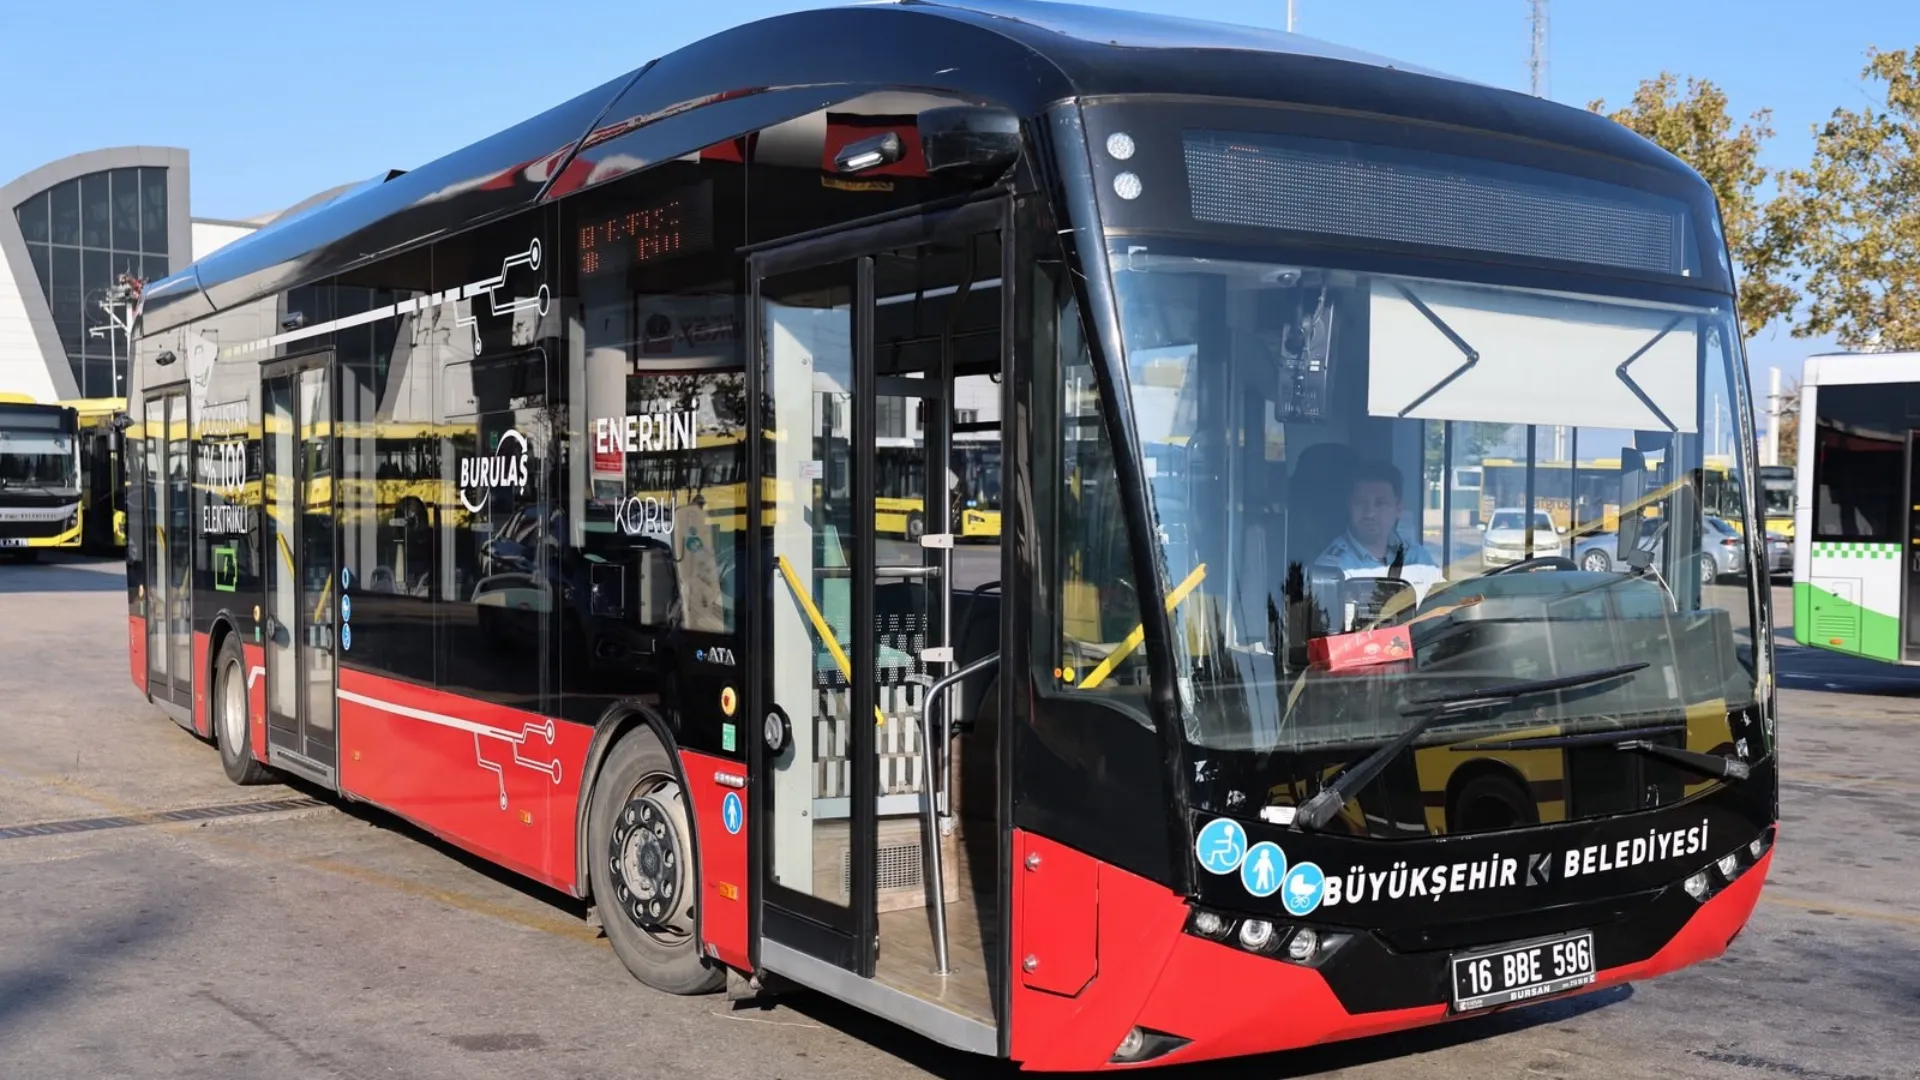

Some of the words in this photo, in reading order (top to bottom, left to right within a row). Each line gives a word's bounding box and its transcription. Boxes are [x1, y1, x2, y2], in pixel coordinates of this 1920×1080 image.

[596, 398, 697, 454] ENERJİNİ
[460, 453, 528, 496] BURULAŞ
[203, 498, 248, 534] ELEKTRİKLİ
[614, 496, 675, 534] KORU
[1323, 853, 1518, 906] BÜYÜKŞEHİR
[1564, 818, 1708, 878] BELEDİYESİ
[1468, 958, 1493, 994] 16
[1502, 949, 1543, 987] BBE
[1552, 939, 1589, 976] 596
[1510, 984, 1551, 1001] BURSAN
